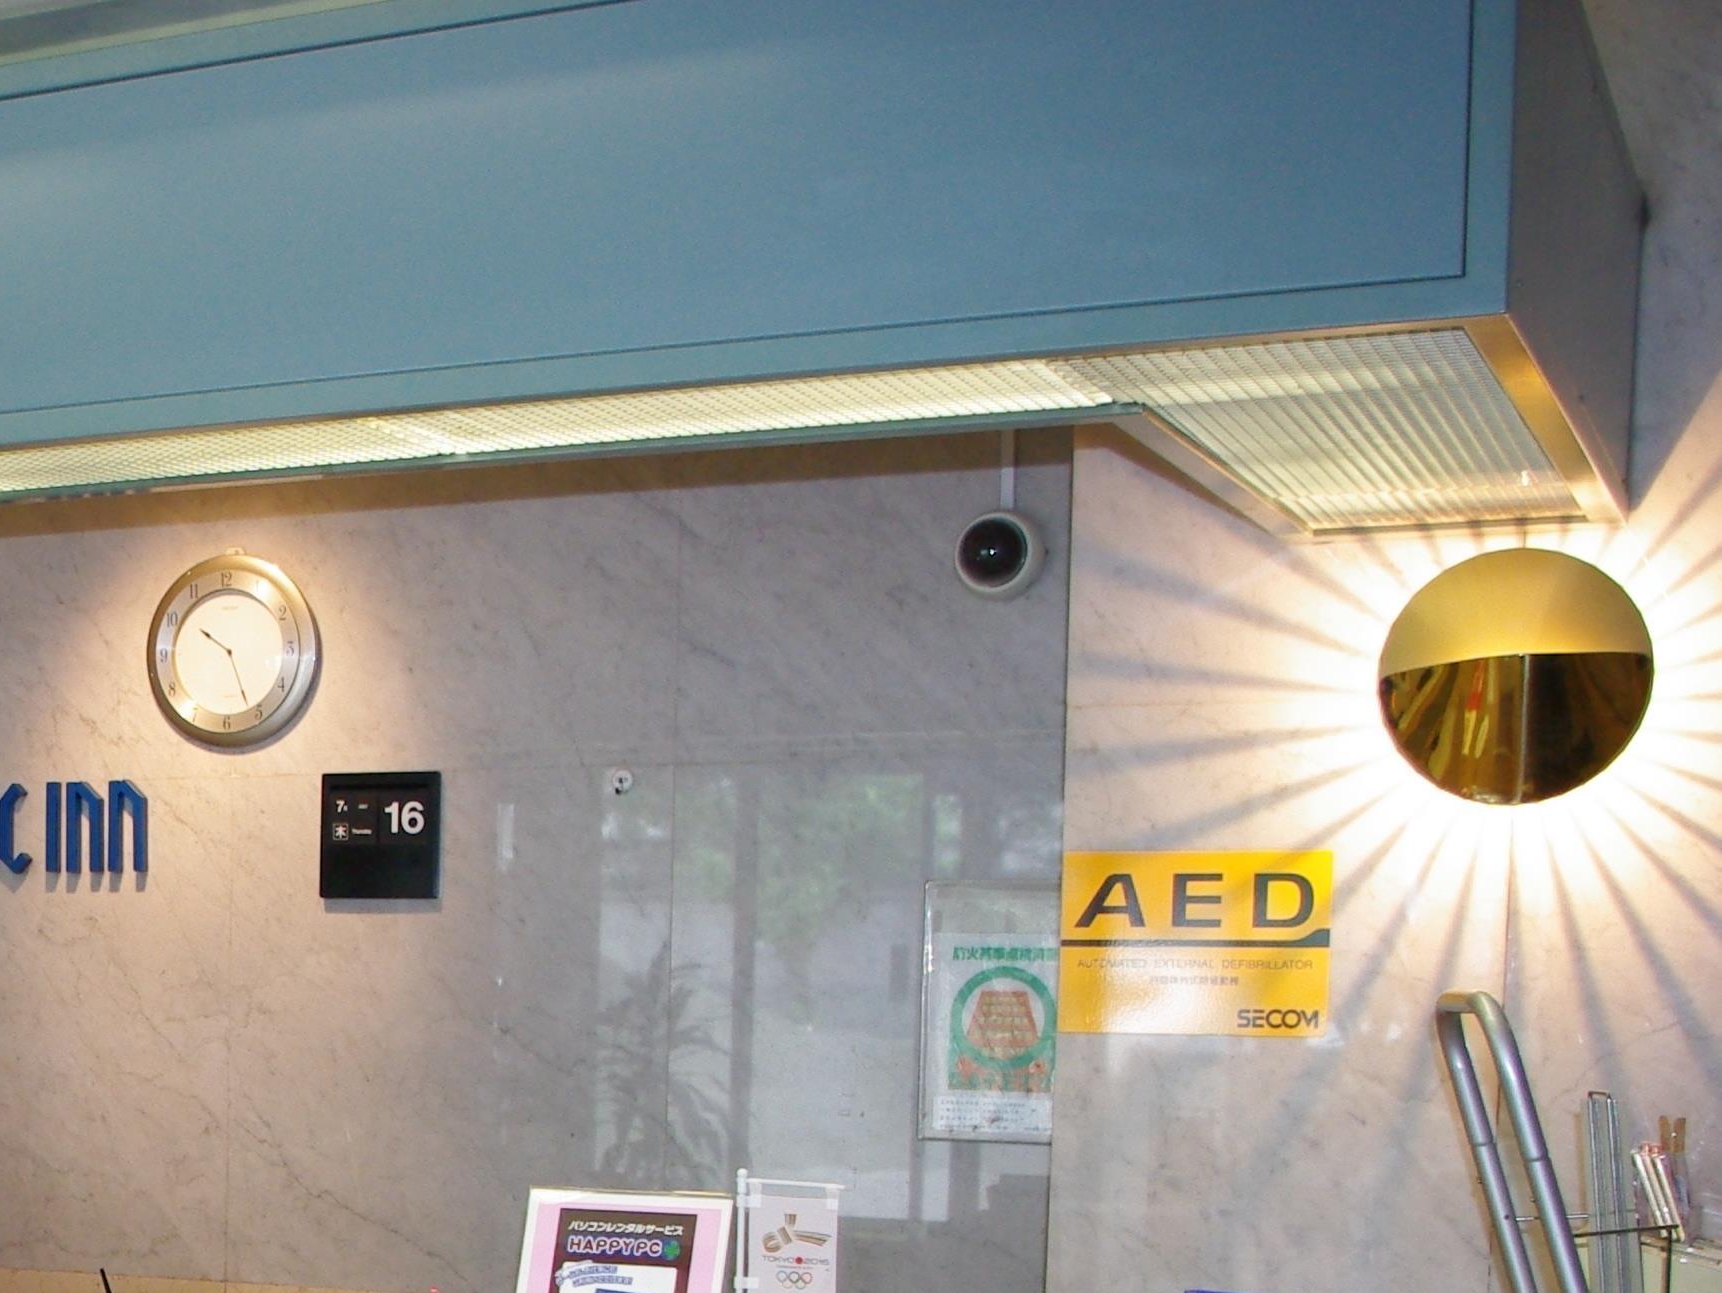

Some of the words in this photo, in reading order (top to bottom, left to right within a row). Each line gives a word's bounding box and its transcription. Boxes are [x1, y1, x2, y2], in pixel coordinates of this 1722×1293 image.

[45, 780, 149, 874] INN
[384, 801, 425, 835] 16
[1074, 873, 1315, 929] AED
[1077, 958, 1148, 969] AUTOMATED
[1154, 958, 1216, 970] EXTERNAL
[1221, 958, 1314, 971] DEFIBRILLATOR
[1236, 1008, 1320, 1030] SECOM
[568, 1220, 684, 1236] パソコンレンタルサービス
[567, 1235, 634, 1256] HAPPY
[633, 1238, 663, 1257] PC
[762, 1255, 795, 1264] TOKYO
